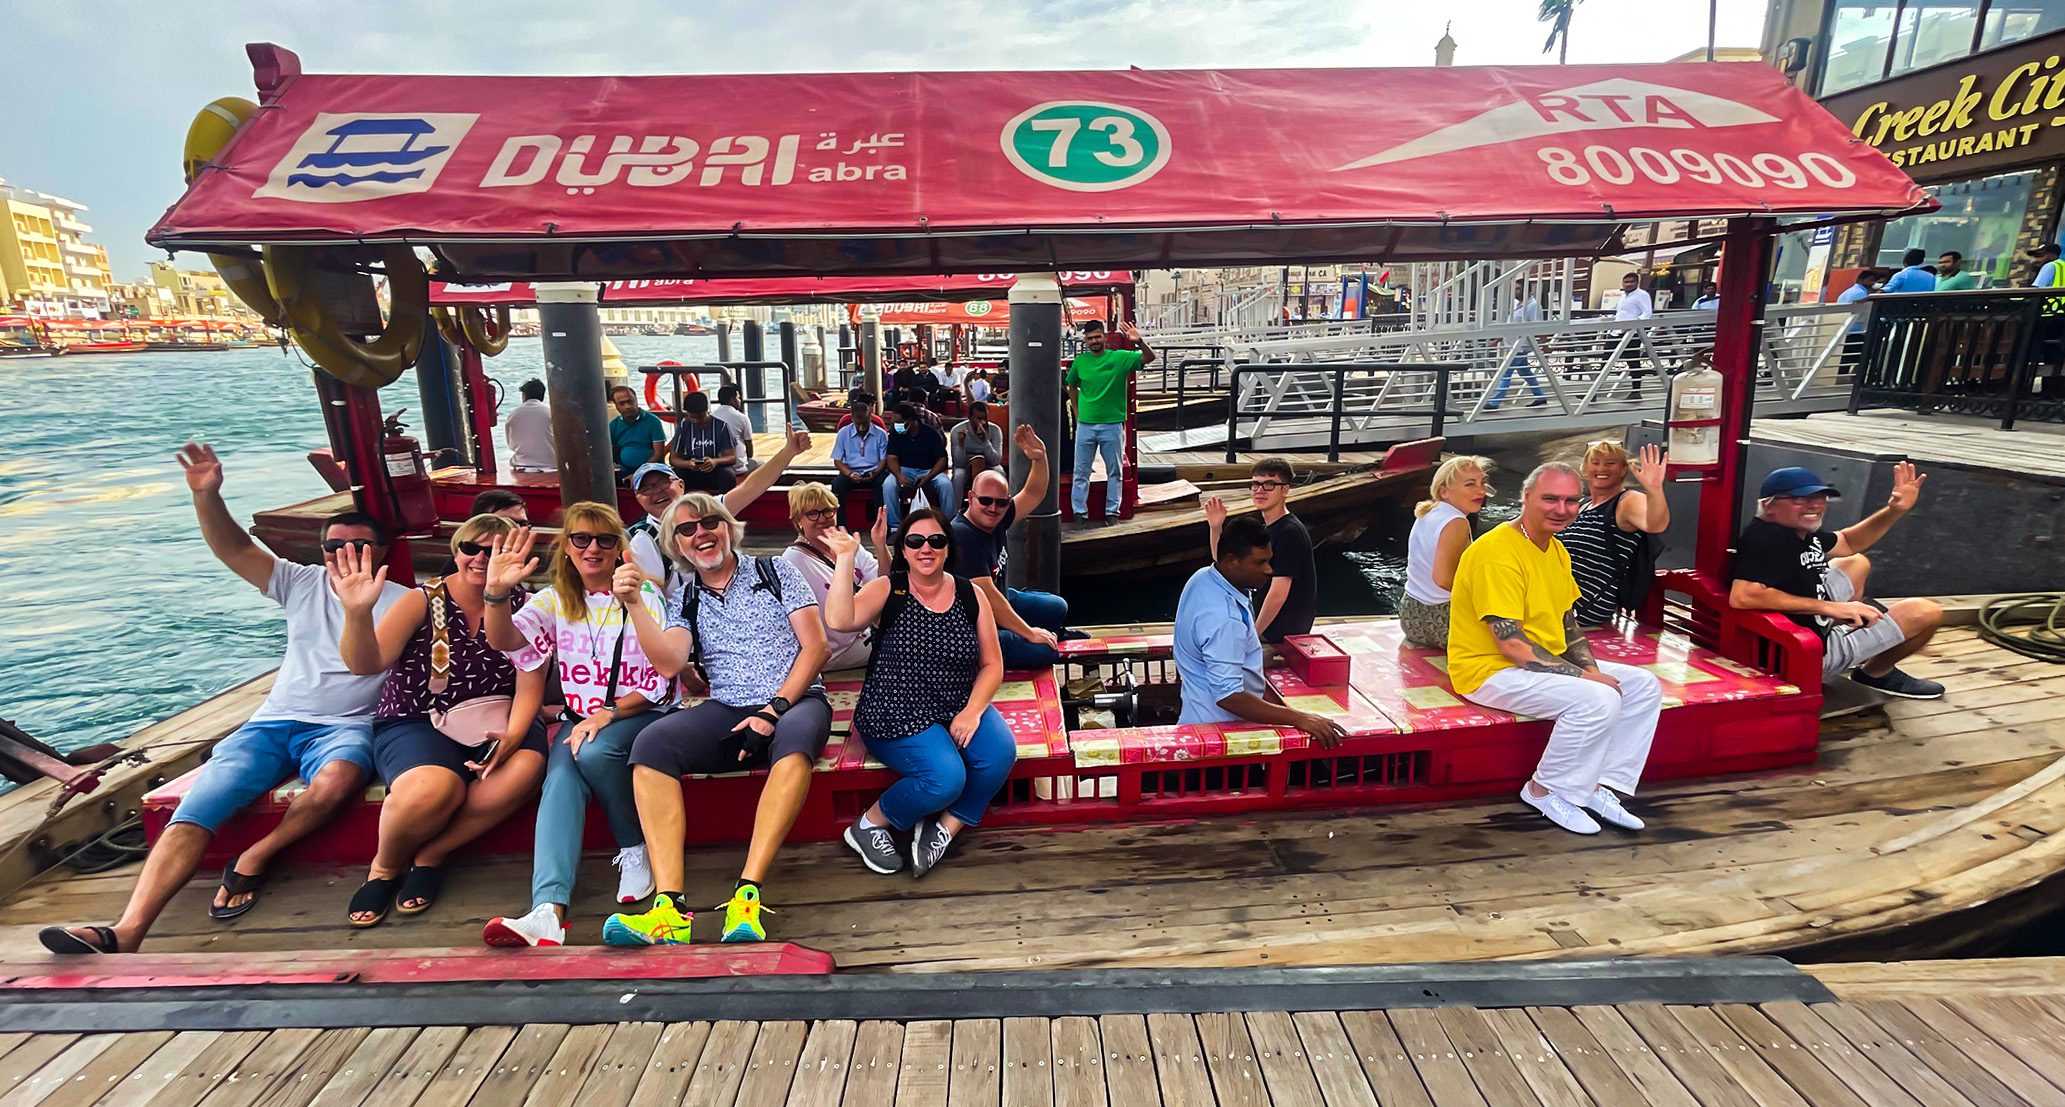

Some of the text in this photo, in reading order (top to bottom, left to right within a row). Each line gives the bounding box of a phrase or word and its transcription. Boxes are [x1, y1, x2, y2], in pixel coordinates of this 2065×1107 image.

[1529, 93, 1698, 128] RTA
[1852, 55, 2065, 147] Creek Cit
[479, 133, 801, 195] DUBAI
[815, 131, 906, 155] عبرة
[1031, 115, 1144, 169] 73
[1882, 123, 2040, 168] STAURANT
[808, 159, 908, 183] abra
[1537, 145, 1857, 190] 8009090
[968, 302, 988, 314] 88
